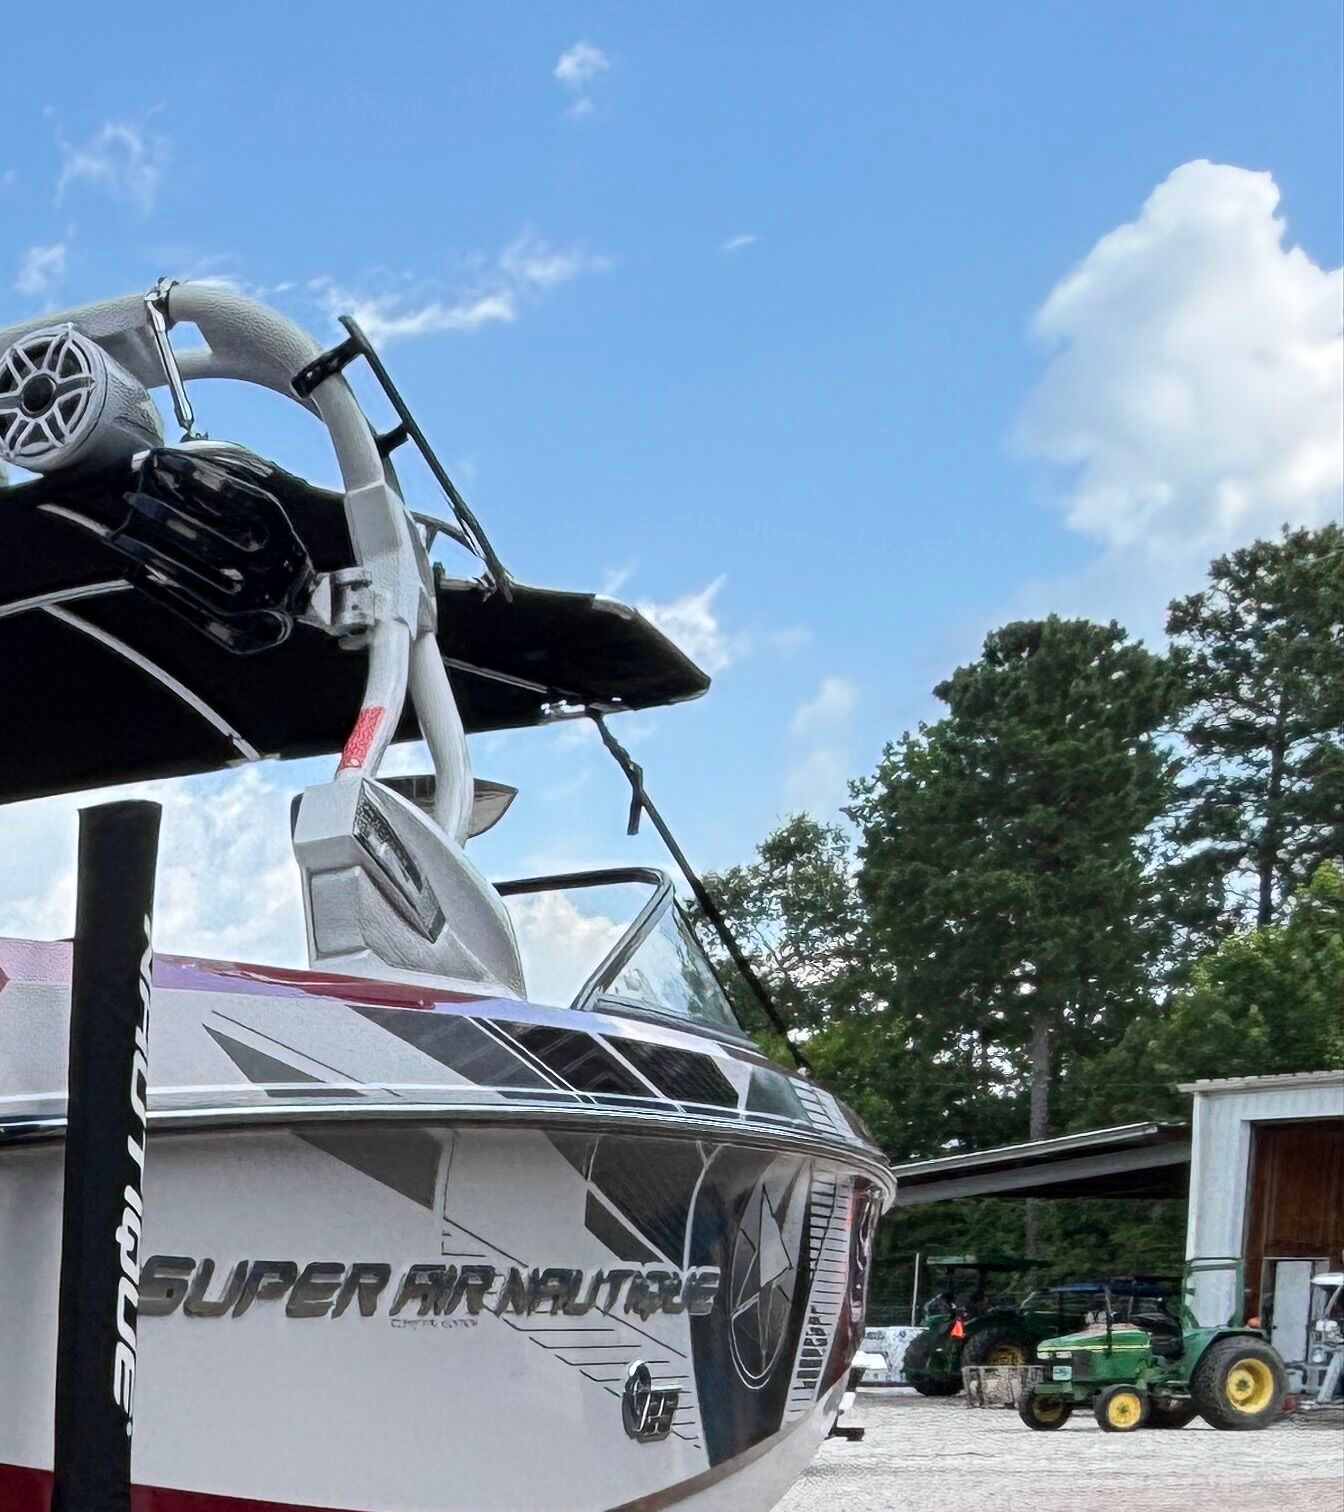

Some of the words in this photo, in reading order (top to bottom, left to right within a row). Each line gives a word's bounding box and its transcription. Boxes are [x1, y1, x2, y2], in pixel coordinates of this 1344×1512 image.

[137, 1254, 391, 1320] SUPER
[389, 1264, 495, 1317] AIR
[496, 1262, 720, 1322] NAUTIQUE
